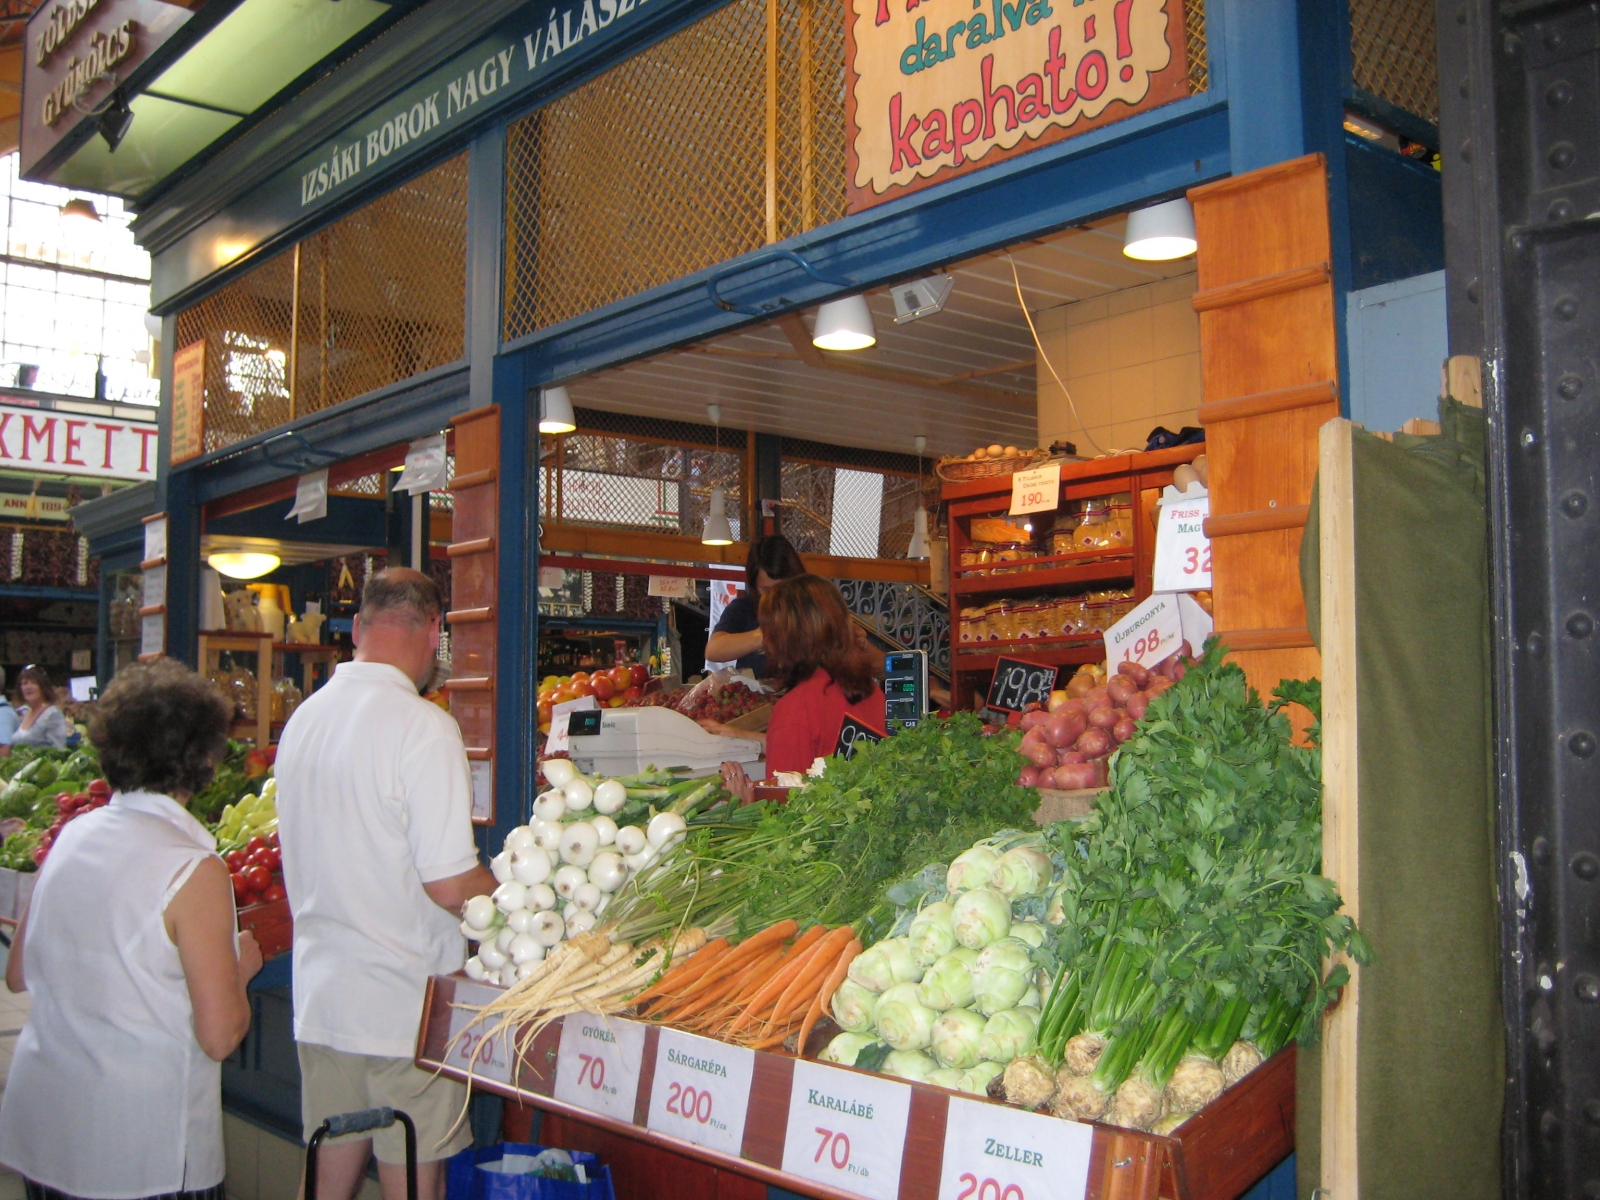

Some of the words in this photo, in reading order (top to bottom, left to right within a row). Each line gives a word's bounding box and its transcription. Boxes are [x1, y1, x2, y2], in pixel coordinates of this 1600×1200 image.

[889, 1, 1134, 174] kapható!
[301, 143, 361, 207] IZSÁKI
[366, 91, 441, 167] BOROK
[446, 45, 515, 118] NAGY
[1020, 491, 1043, 507] 190
[1170, 509, 1200, 520] FRISS
[1177, 523, 1203, 534] MAG
[1123, 628, 1160, 663] 198
[577, 1053, 605, 1090] 70
[667, 1048, 727, 1078] SÁRGARÉPA
[666, 1081, 712, 1124] 200
[808, 1088, 874, 1120] KARALÁBÉ
[814, 1126, 850, 1170] 70
[984, 1137, 1044, 1168] ZELLER
